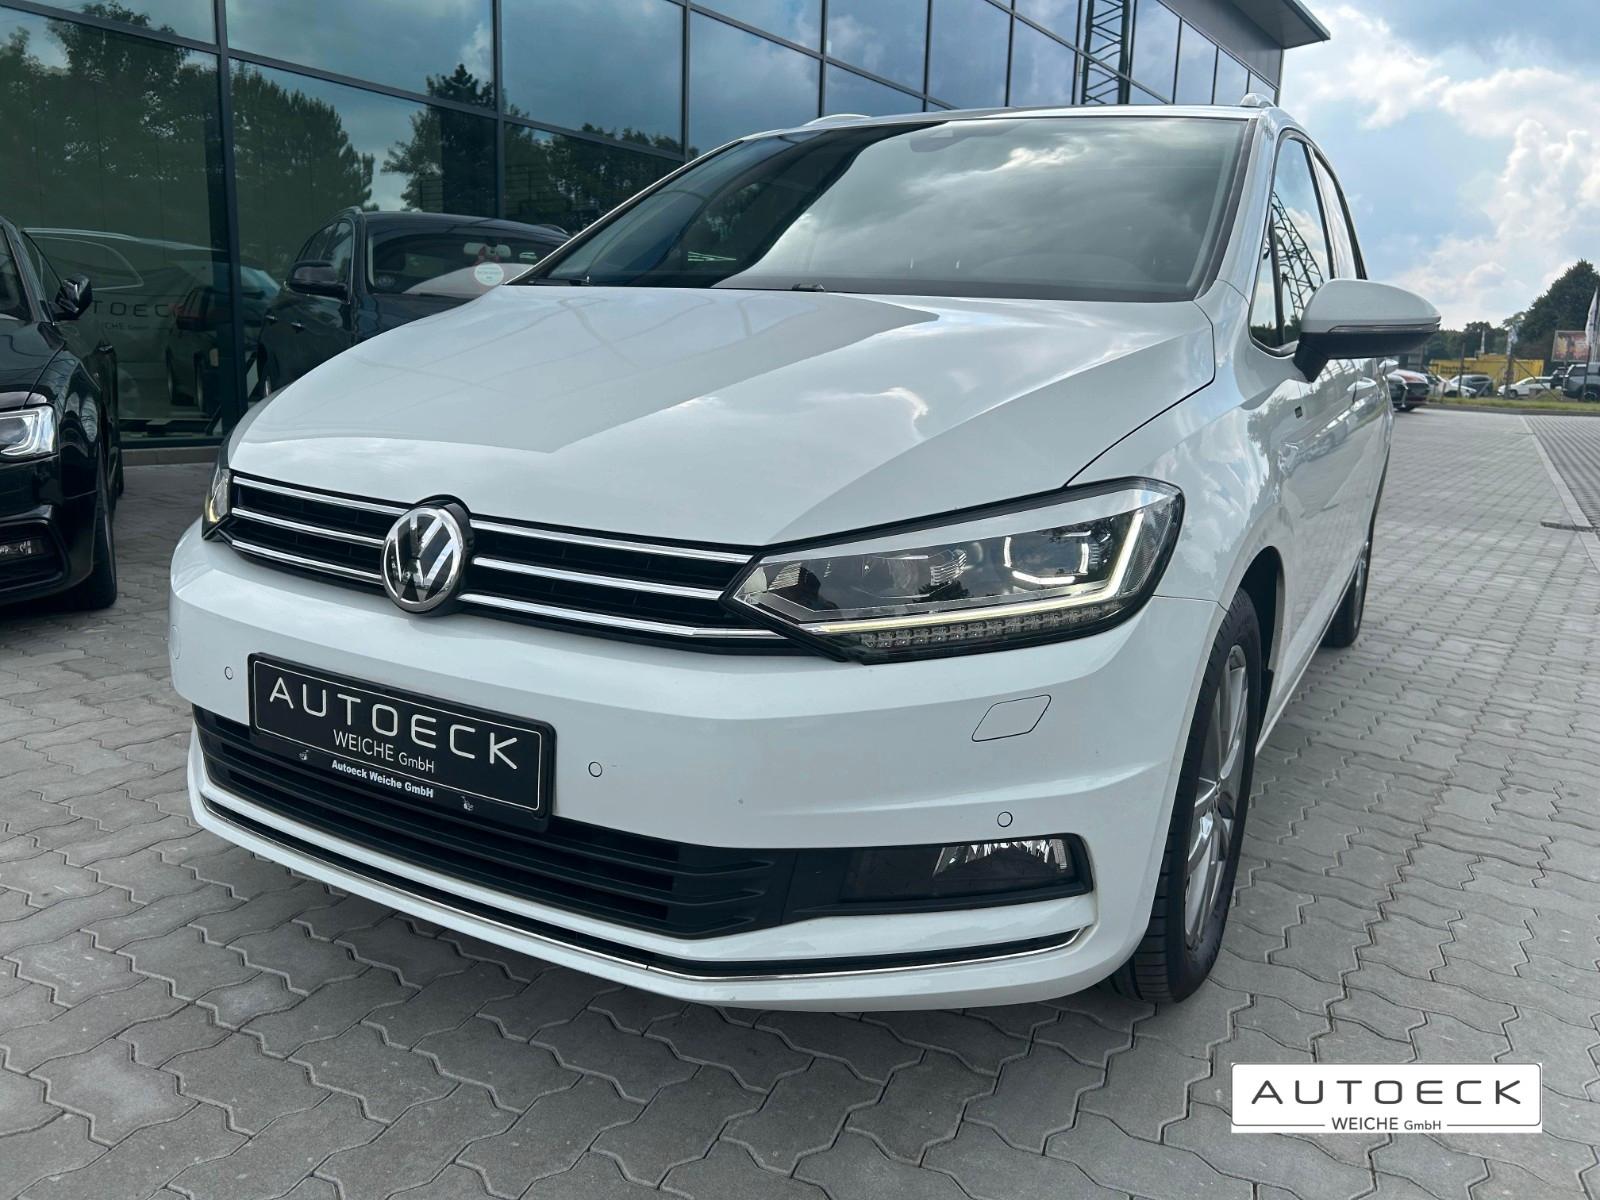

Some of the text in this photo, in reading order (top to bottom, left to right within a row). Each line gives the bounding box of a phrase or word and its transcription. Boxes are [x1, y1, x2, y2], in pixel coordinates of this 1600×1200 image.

[384, 508, 462, 611] VW
[269, 677, 518, 770] AUTOECK
[333, 729, 435, 774] WEICHE GmbH
[331, 759, 434, 798] Autoeck Weiche GmbH
